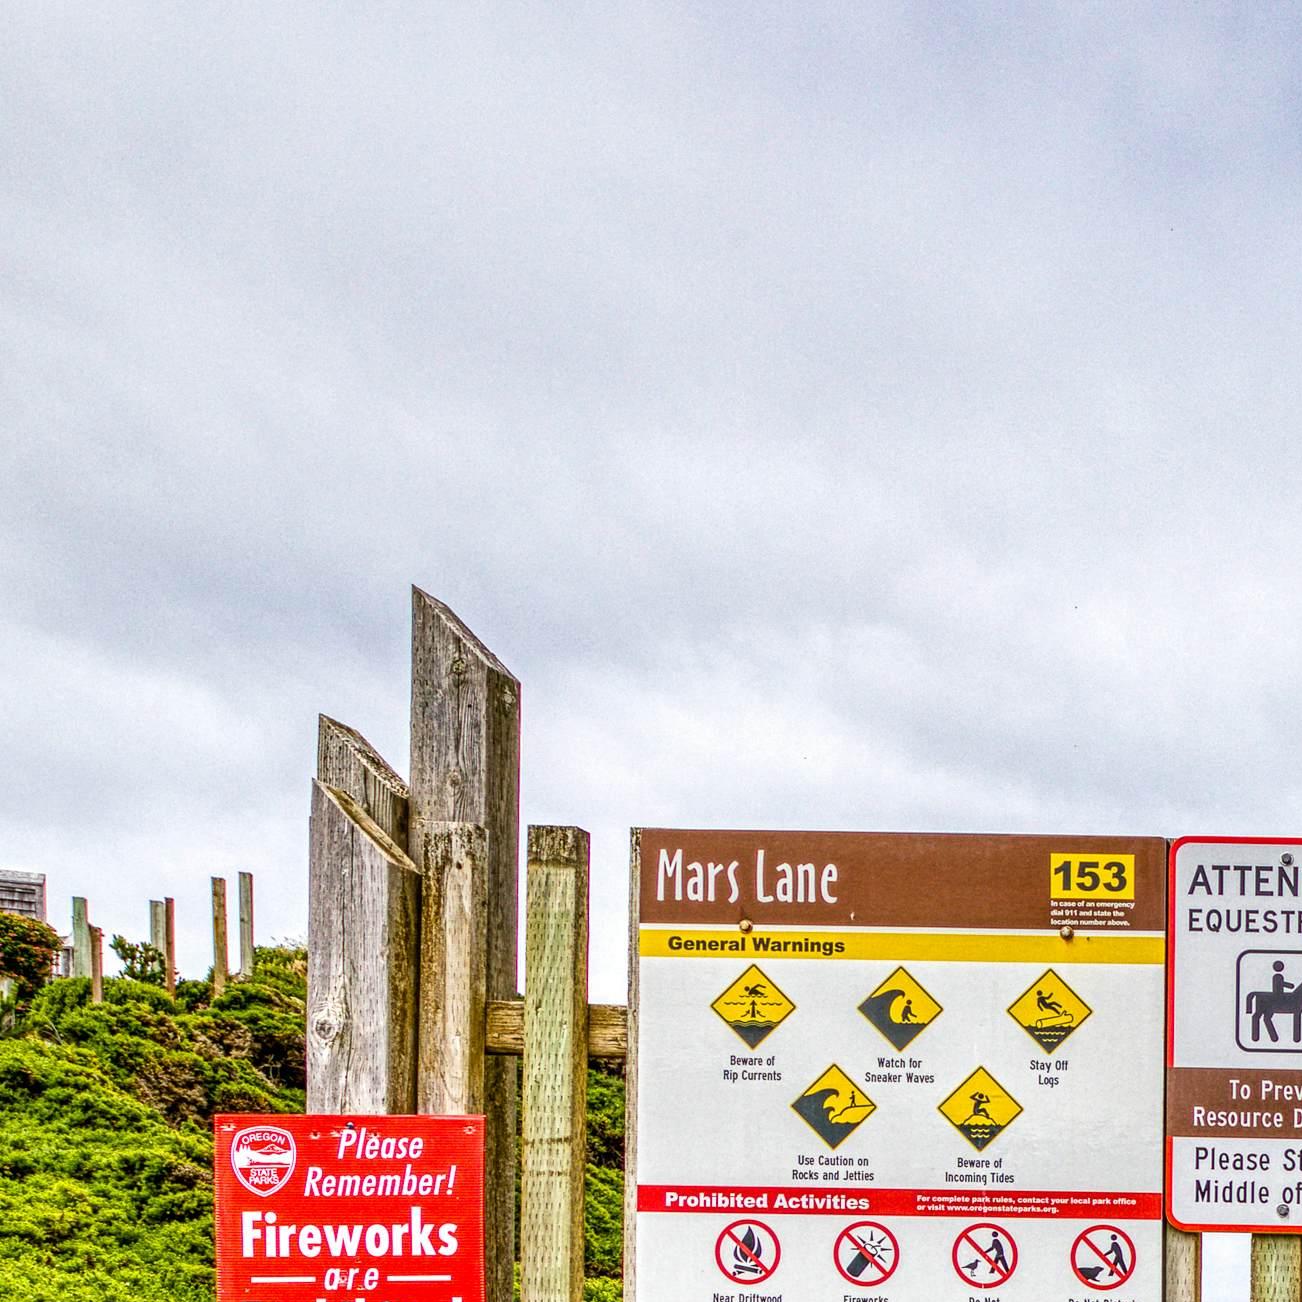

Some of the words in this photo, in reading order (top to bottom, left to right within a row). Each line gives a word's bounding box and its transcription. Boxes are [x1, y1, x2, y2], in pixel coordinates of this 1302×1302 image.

[656, 848, 739, 904] Mars
[757, 849, 838, 904] Lane
[1054, 861, 1127, 891] 153
[668, 936, 746, 952] General
[753, 938, 845, 955] Warnings
[730, 1056, 762, 1067] Beware
[766, 1056, 775, 1066] of
[877, 1058, 905, 1068] Watch
[909, 1058, 922, 1068] for
[1030, 1060, 1051, 1072] Stay
[1055, 1060, 1068, 1070] Off
[723, 1070, 738, 1083] Rip
[742, 1071, 782, 1081] Currents
[865, 1072, 902, 1082] Sneaker
[906, 1073, 934, 1083] Waves
[1038, 1075, 1059, 1088] Logs
[1230, 1080, 1250, 1099] To
[1193, 1107, 1284, 1128] Resource
[242, 1132, 285, 1144] OREGON
[337, 1128, 424, 1159] Please
[798, 1156, 814, 1166] Use
[818, 1156, 853, 1166] Caution
[858, 1158, 869, 1167] on
[957, 1158, 990, 1169] Beware
[994, 1158, 1002, 1169] of
[1194, 1147, 1270, 1171] Please
[250, 1168, 277, 1176] STATE
[792, 1170, 819, 1180] Rocks
[823, 1171, 839, 1181] and
[843, 1171, 874, 1181] Jetties
[945, 1172, 987, 1185] Incoming
[991, 1173, 1014, 1183] Tides
[249, 1176, 279, 1184] PARKS
[304, 1164, 456, 1197] Remember!
[1194, 1180, 1270, 1203] Middle
[1282, 1182, 1302, 1204] of
[665, 1192, 768, 1208] Prohibited
[774, 1194, 870, 1210] Activities
[932, 1196, 970, 1204] complete
[972, 1196, 990, 1204] park
[992, 1196, 1015, 1204] rules,
[947, 1204, 1059, 1213] www.oregonstateparks.org.
[241, 1207, 458, 1258] Fireworks
[324, 1267, 379, 1291] are
